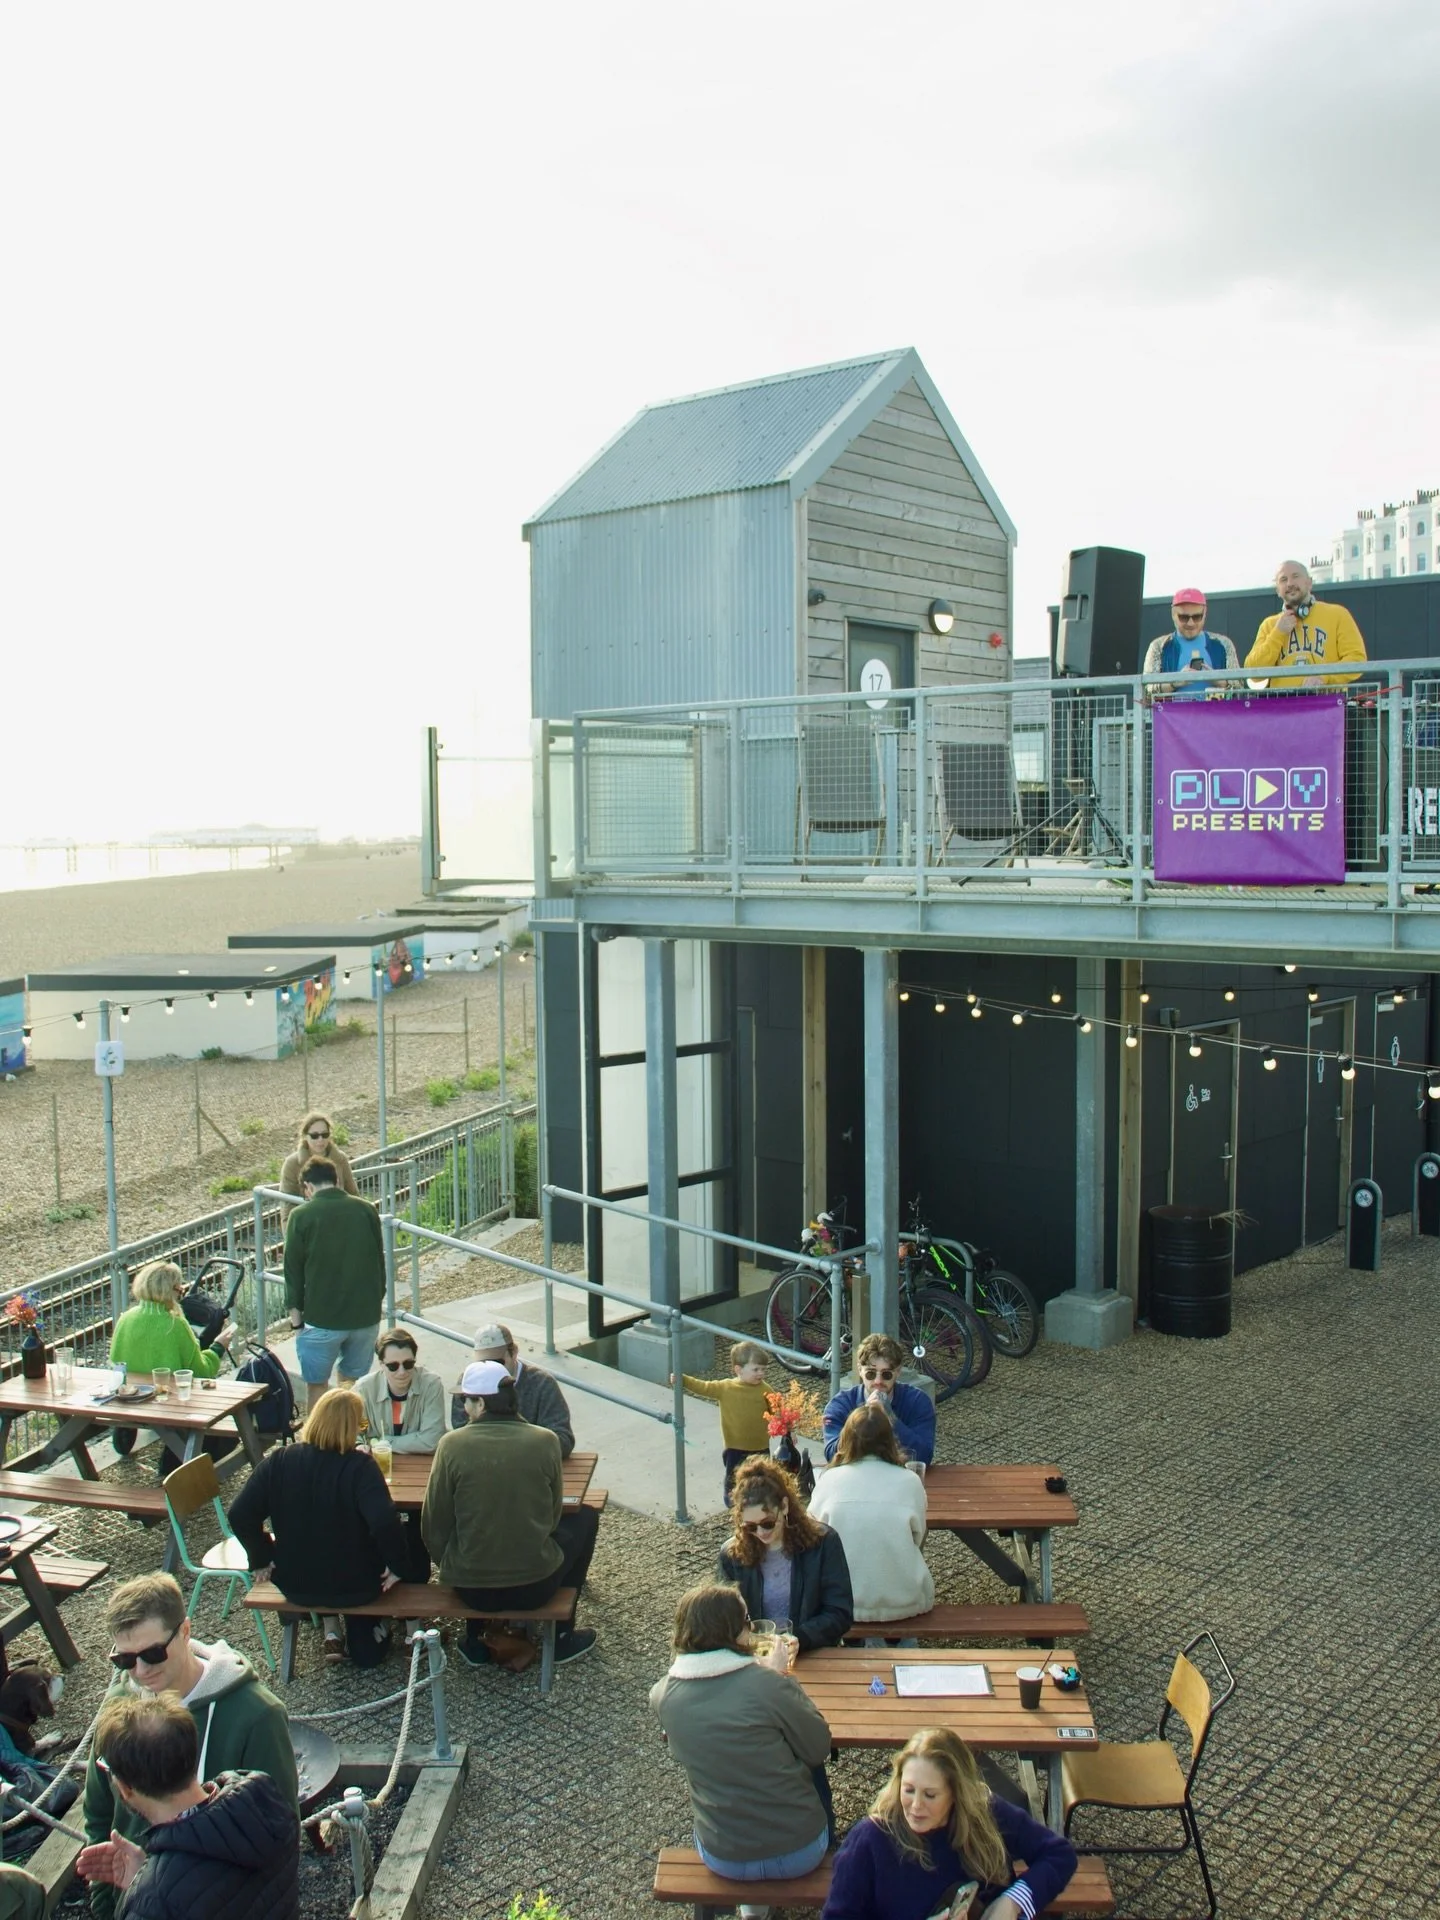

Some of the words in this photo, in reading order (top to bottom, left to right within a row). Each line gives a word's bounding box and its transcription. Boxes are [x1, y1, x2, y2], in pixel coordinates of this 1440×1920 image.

[869, 673, 883, 691] 17
[1408, 787, 1440, 835] RE
[1172, 813, 1325, 831] PRESENTS
